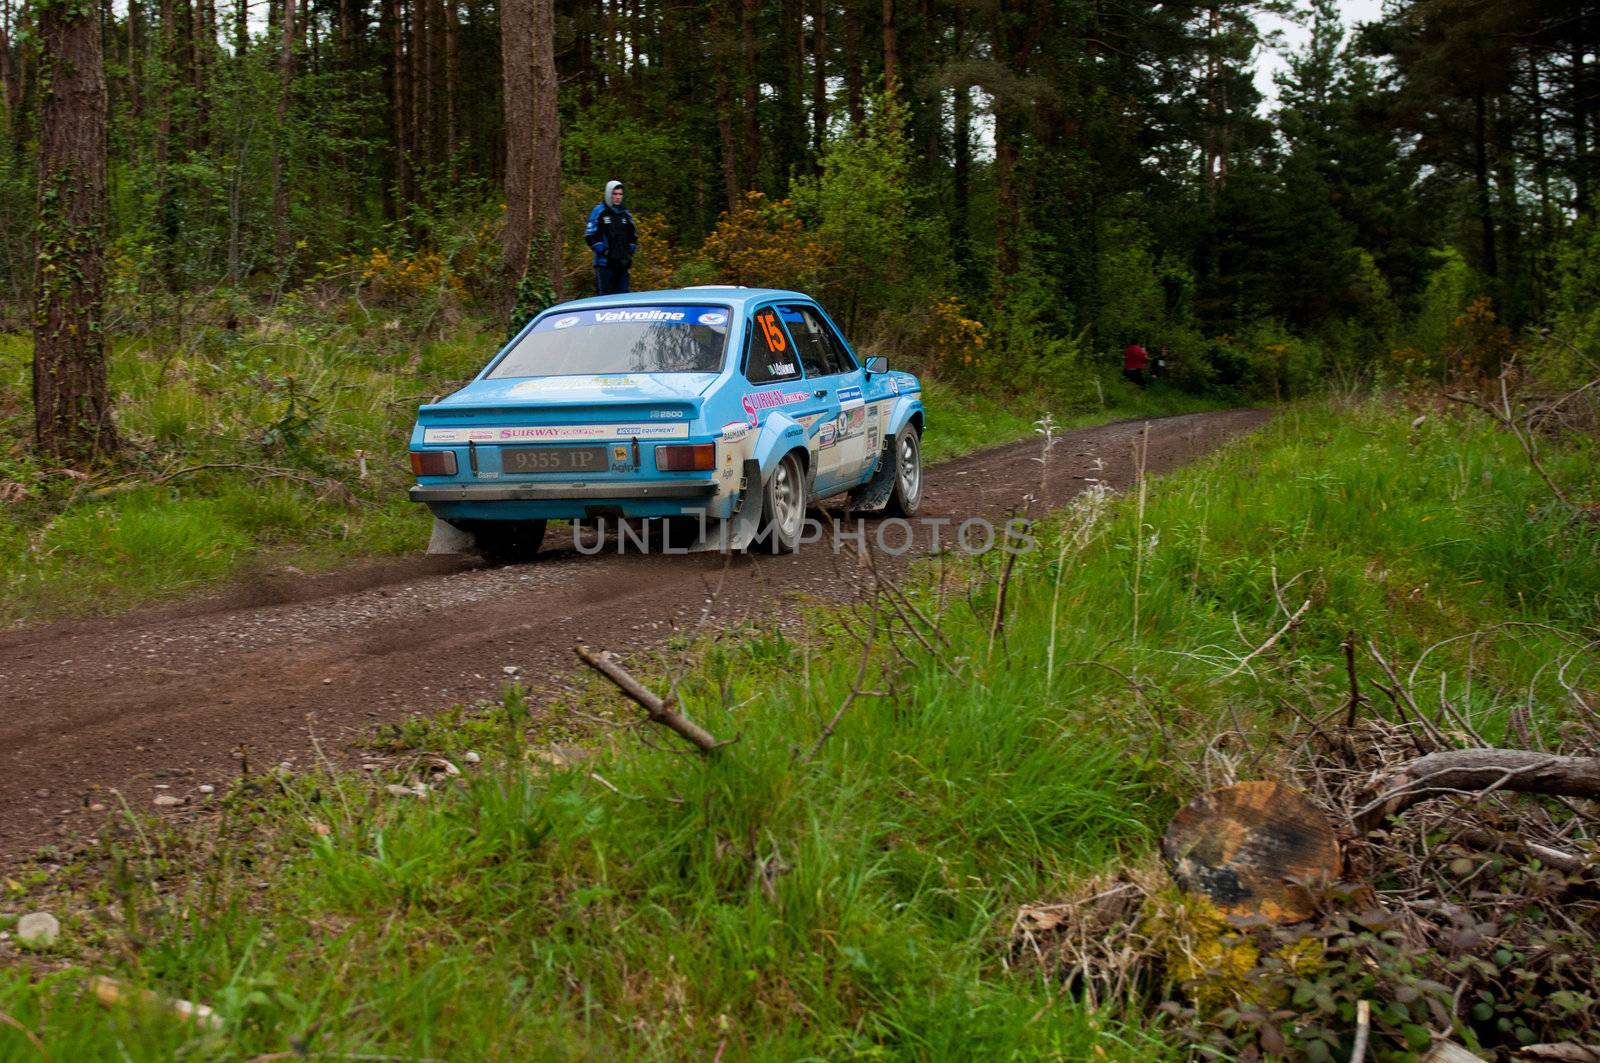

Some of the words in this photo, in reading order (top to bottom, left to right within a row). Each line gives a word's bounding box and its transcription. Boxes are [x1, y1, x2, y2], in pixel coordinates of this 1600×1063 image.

[595, 311, 685, 322] Valvoline
[757, 313, 786, 352] 15
[500, 429, 560, 439] SUIRWAY
[515, 452, 560, 469] 9355
[569, 451, 593, 467] IP
